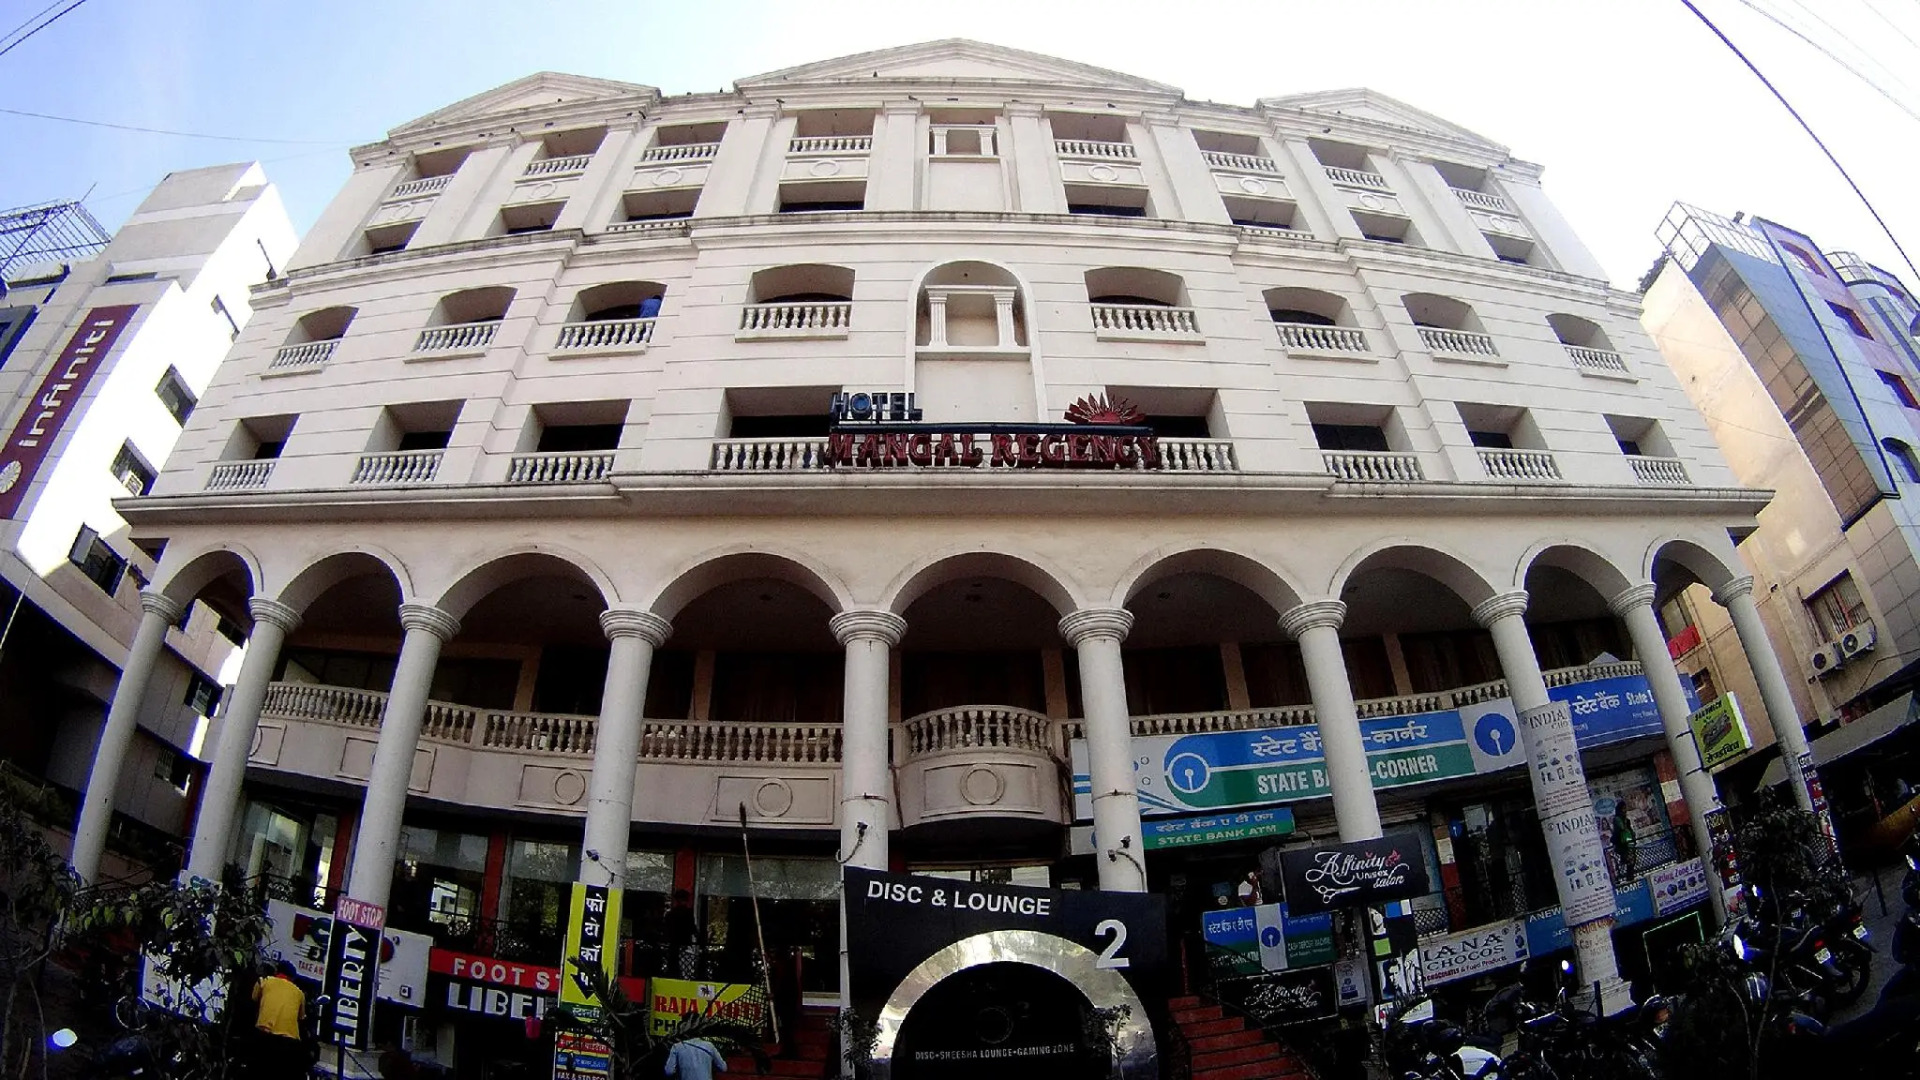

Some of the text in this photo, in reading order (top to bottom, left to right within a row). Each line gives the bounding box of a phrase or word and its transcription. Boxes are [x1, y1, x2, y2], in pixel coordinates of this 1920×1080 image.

[830, 391, 923, 423] HOTEL
[823, 432, 1163, 470] MANGAL REGENCY
[1572, 689, 1621, 716] स्टेट बैंक
[1551, 719, 1570, 731] CHO
[1250, 735, 1298, 757] स्टेट
[1299, 731, 1324, 752] बैं
[1257, 770, 1310, 795] STATE
[1158, 824, 1277, 846] STATE BANK ATM
[1305, 851, 1386, 886] Affinity
[1356, 869, 1389, 881] Unisex
[867, 880, 1051, 916] DISC & LOUNGE
[1615, 880, 1644, 896] HOME
[338, 899, 382, 927] FOOT STOP
[1094, 919, 1130, 969] 2
[453, 957, 526, 986] FOOT
[1426, 944, 1505, 972] CHOCOS
[654, 995, 700, 1018] RAJA
[1052, 1043, 1075, 1054] ZONE
